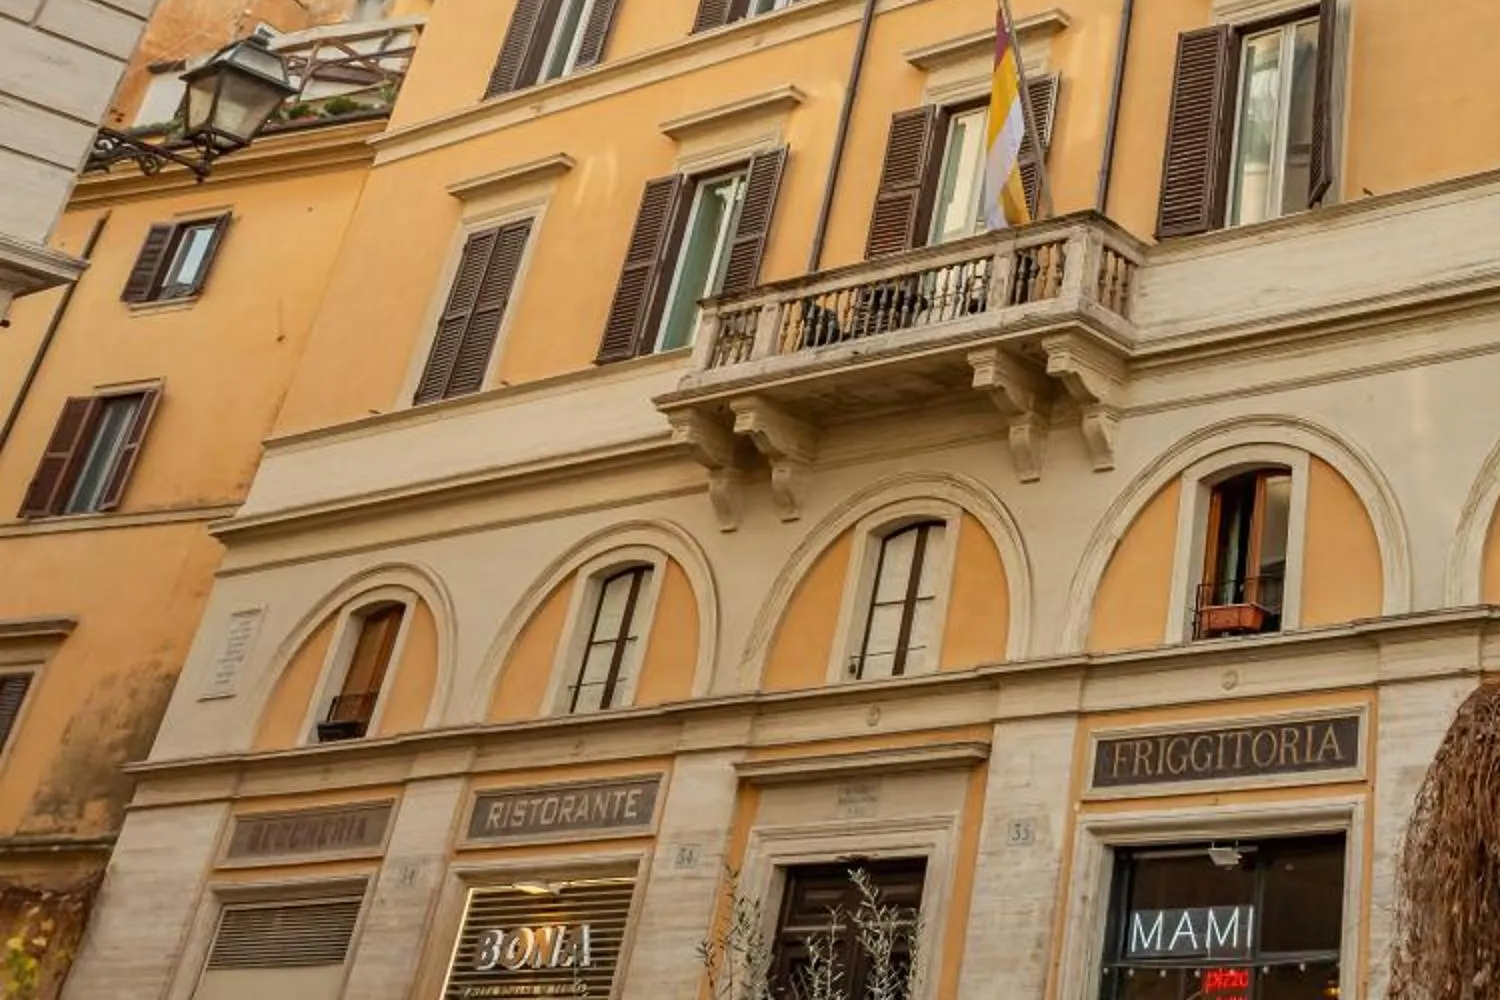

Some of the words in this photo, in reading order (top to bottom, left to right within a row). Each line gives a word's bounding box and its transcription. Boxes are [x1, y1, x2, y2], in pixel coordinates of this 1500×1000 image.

[1111, 724, 1345, 778] FRIGGITORIA
[485, 788, 643, 829] RISTORANTE
[473, 924, 591, 971] BONA
[1131, 906, 1254, 952] MAMI
